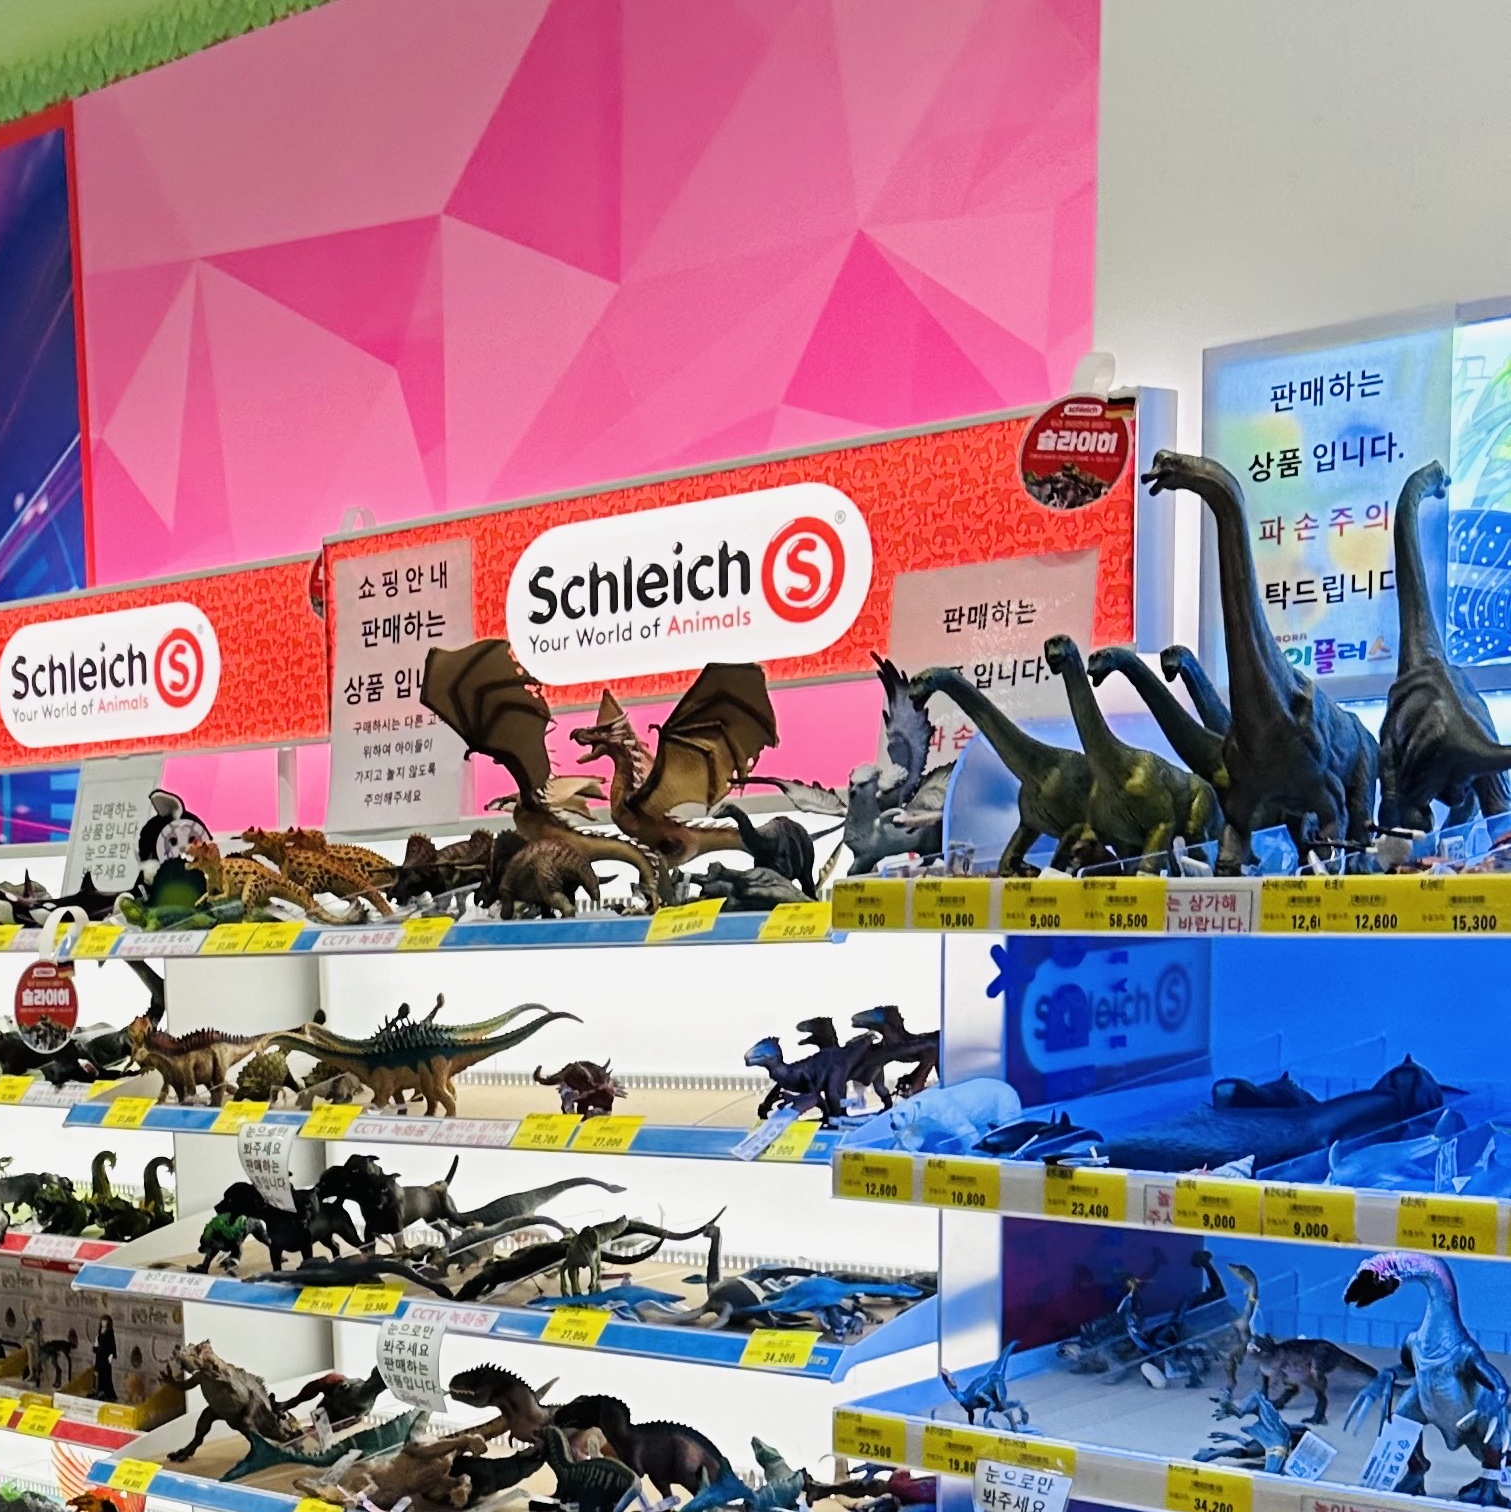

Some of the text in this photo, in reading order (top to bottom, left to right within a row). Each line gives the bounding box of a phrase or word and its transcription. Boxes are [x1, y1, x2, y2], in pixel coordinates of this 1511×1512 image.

[1269, 370, 1385, 412] 판매하는
[1247, 431, 1406, 482] 상품 입니다.
[1258, 500, 1391, 546] 파손주의
[358, 560, 448, 600] 쇼핑안내
[527, 538, 751, 624] Schleich
[1264, 568, 1395, 610] 탁드립니
[943, 599, 1037, 634] 판매하는
[361, 610, 446, 648] 판매하는
[529, 606, 752, 655] Your World of Animals
[1283, 634, 1393, 676] 이플러스
[11, 641, 147, 700] Schleich
[974, 655, 1050, 689] 입니다.
[344, 672, 385, 705] 상품
[11, 694, 149, 723] Your World of Animals
[353, 714, 424, 735] 구매하시는 다른
[363, 738, 434, 760] 위하여 아이들이
[354, 767, 383, 784] 가지고
[363, 789, 422, 807] 주의해주세요
[92, 802, 138, 820] 판매하는
[82, 823, 139, 841] 상품입니다
[85, 843, 131, 861] 눈으로만
[1188, 894, 1238, 911] 삼가해
[858, 913, 886, 928] 8,100
[940, 913, 974, 928] 10,800
[1030, 913, 1061, 929] 9,000
[1109, 913, 1148, 928] 58,500
[1291, 915, 1320, 929] 12,6
[1354, 914, 1398, 929] 12,600
[1451, 915, 1497, 931] 15,300
[321, 935, 356, 946] CCTV
[353, 1122, 389, 1135] CCTV
[951, 1192, 986, 1207] 10,800
[1071, 1203, 1110, 1219] 23,400
[1202, 1213, 1236, 1229] 9,000
[1293, 1221, 1329, 1237] 9,000
[1431, 1233, 1476, 1250] 12,600
[410, 1307, 447, 1321] CCTV
[387, 1323, 435, 1339] 눈으로만
[383, 1340, 429, 1357] 봐주세요
[384, 1356, 429, 1376] 판매하는
[858, 1442, 892, 1459] 22,500
[947, 1457, 976, 1473] 19,80
[984, 1465, 1055, 1495] 눈으로만
